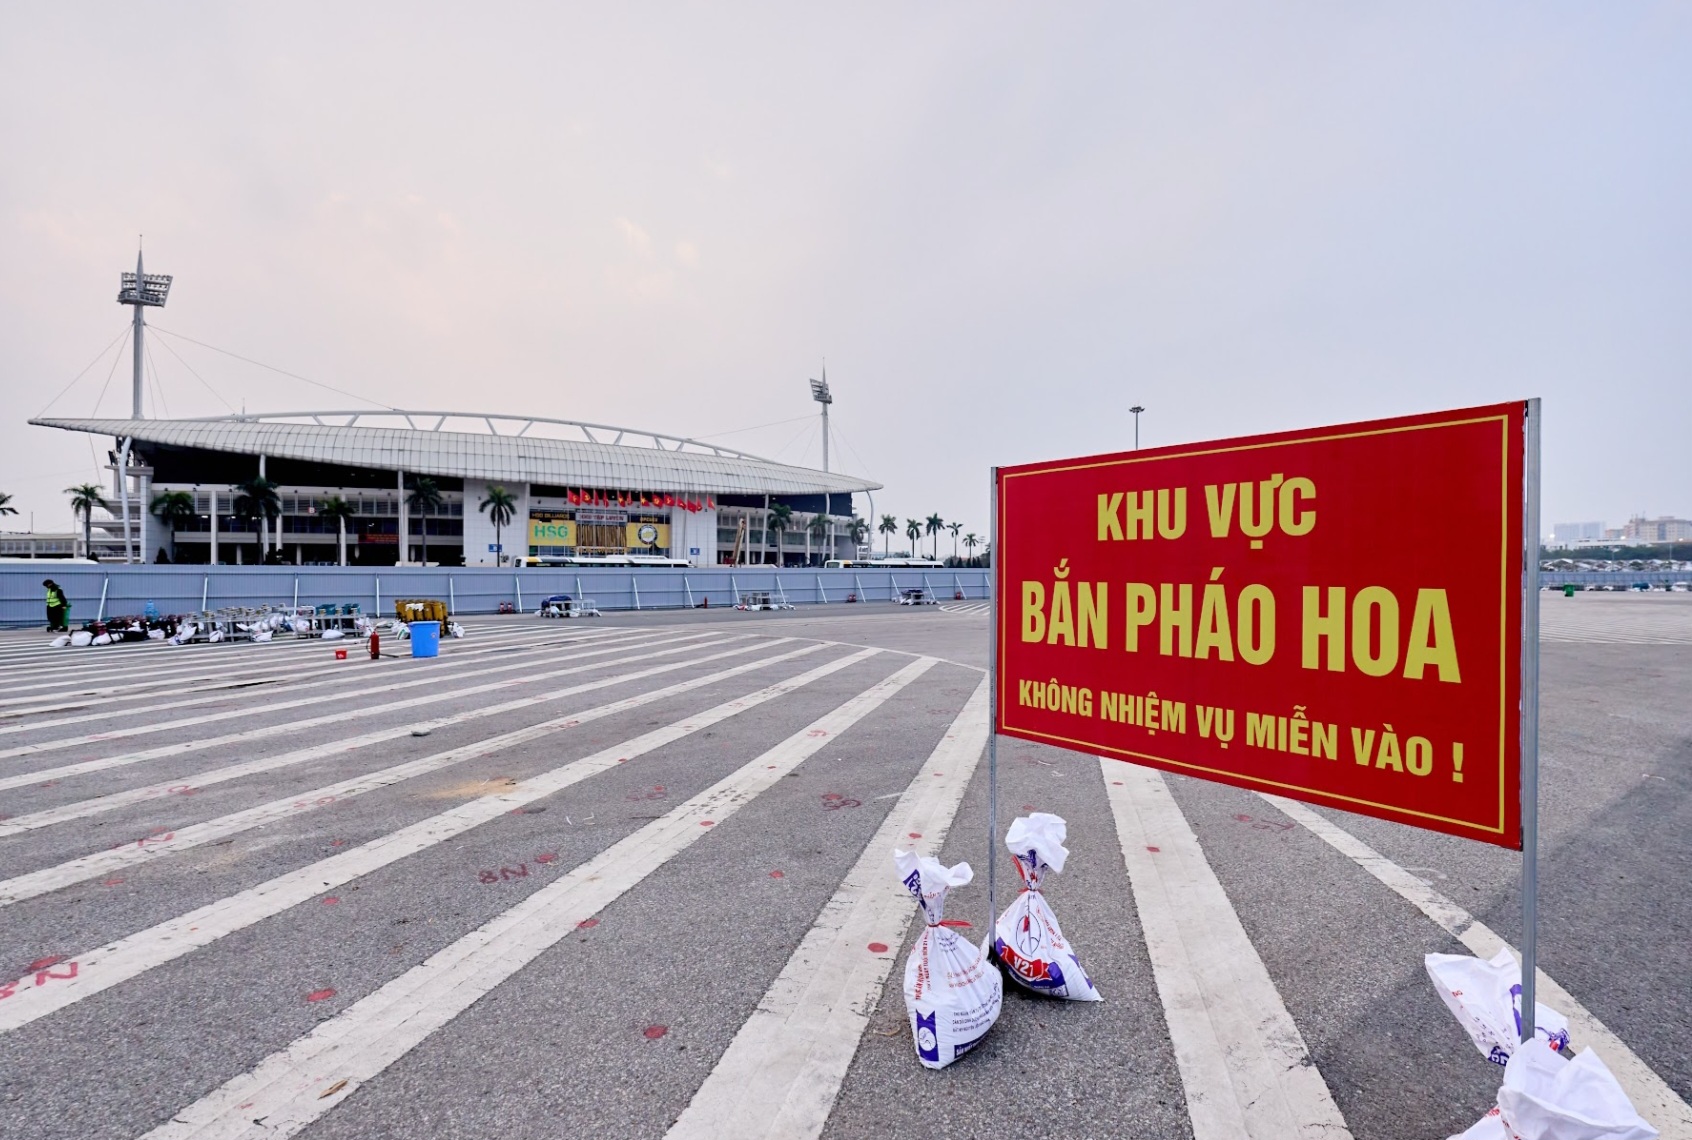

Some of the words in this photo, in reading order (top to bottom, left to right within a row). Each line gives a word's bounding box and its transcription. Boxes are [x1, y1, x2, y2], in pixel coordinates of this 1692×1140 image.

[534, 524, 568, 539] HSG
[1097, 487, 1187, 541] KHU
[1205, 473, 1316, 550] VỰC
[1021, 558, 1108, 650] BẮN
[1125, 567, 1276, 666] PHÁO
[1301, 585, 1462, 684] HOA
[1019, 677, 1093, 717] KHÔNG
[1100, 690, 1186, 738] NHIỆM
[1195, 704, 1235, 749] VỤ
[1246, 704, 1338, 761] MIỄN
[1351, 724, 1433, 777] VÀO
[1452, 741, 1464, 784] !
[1013, 956, 1035, 977] V21
